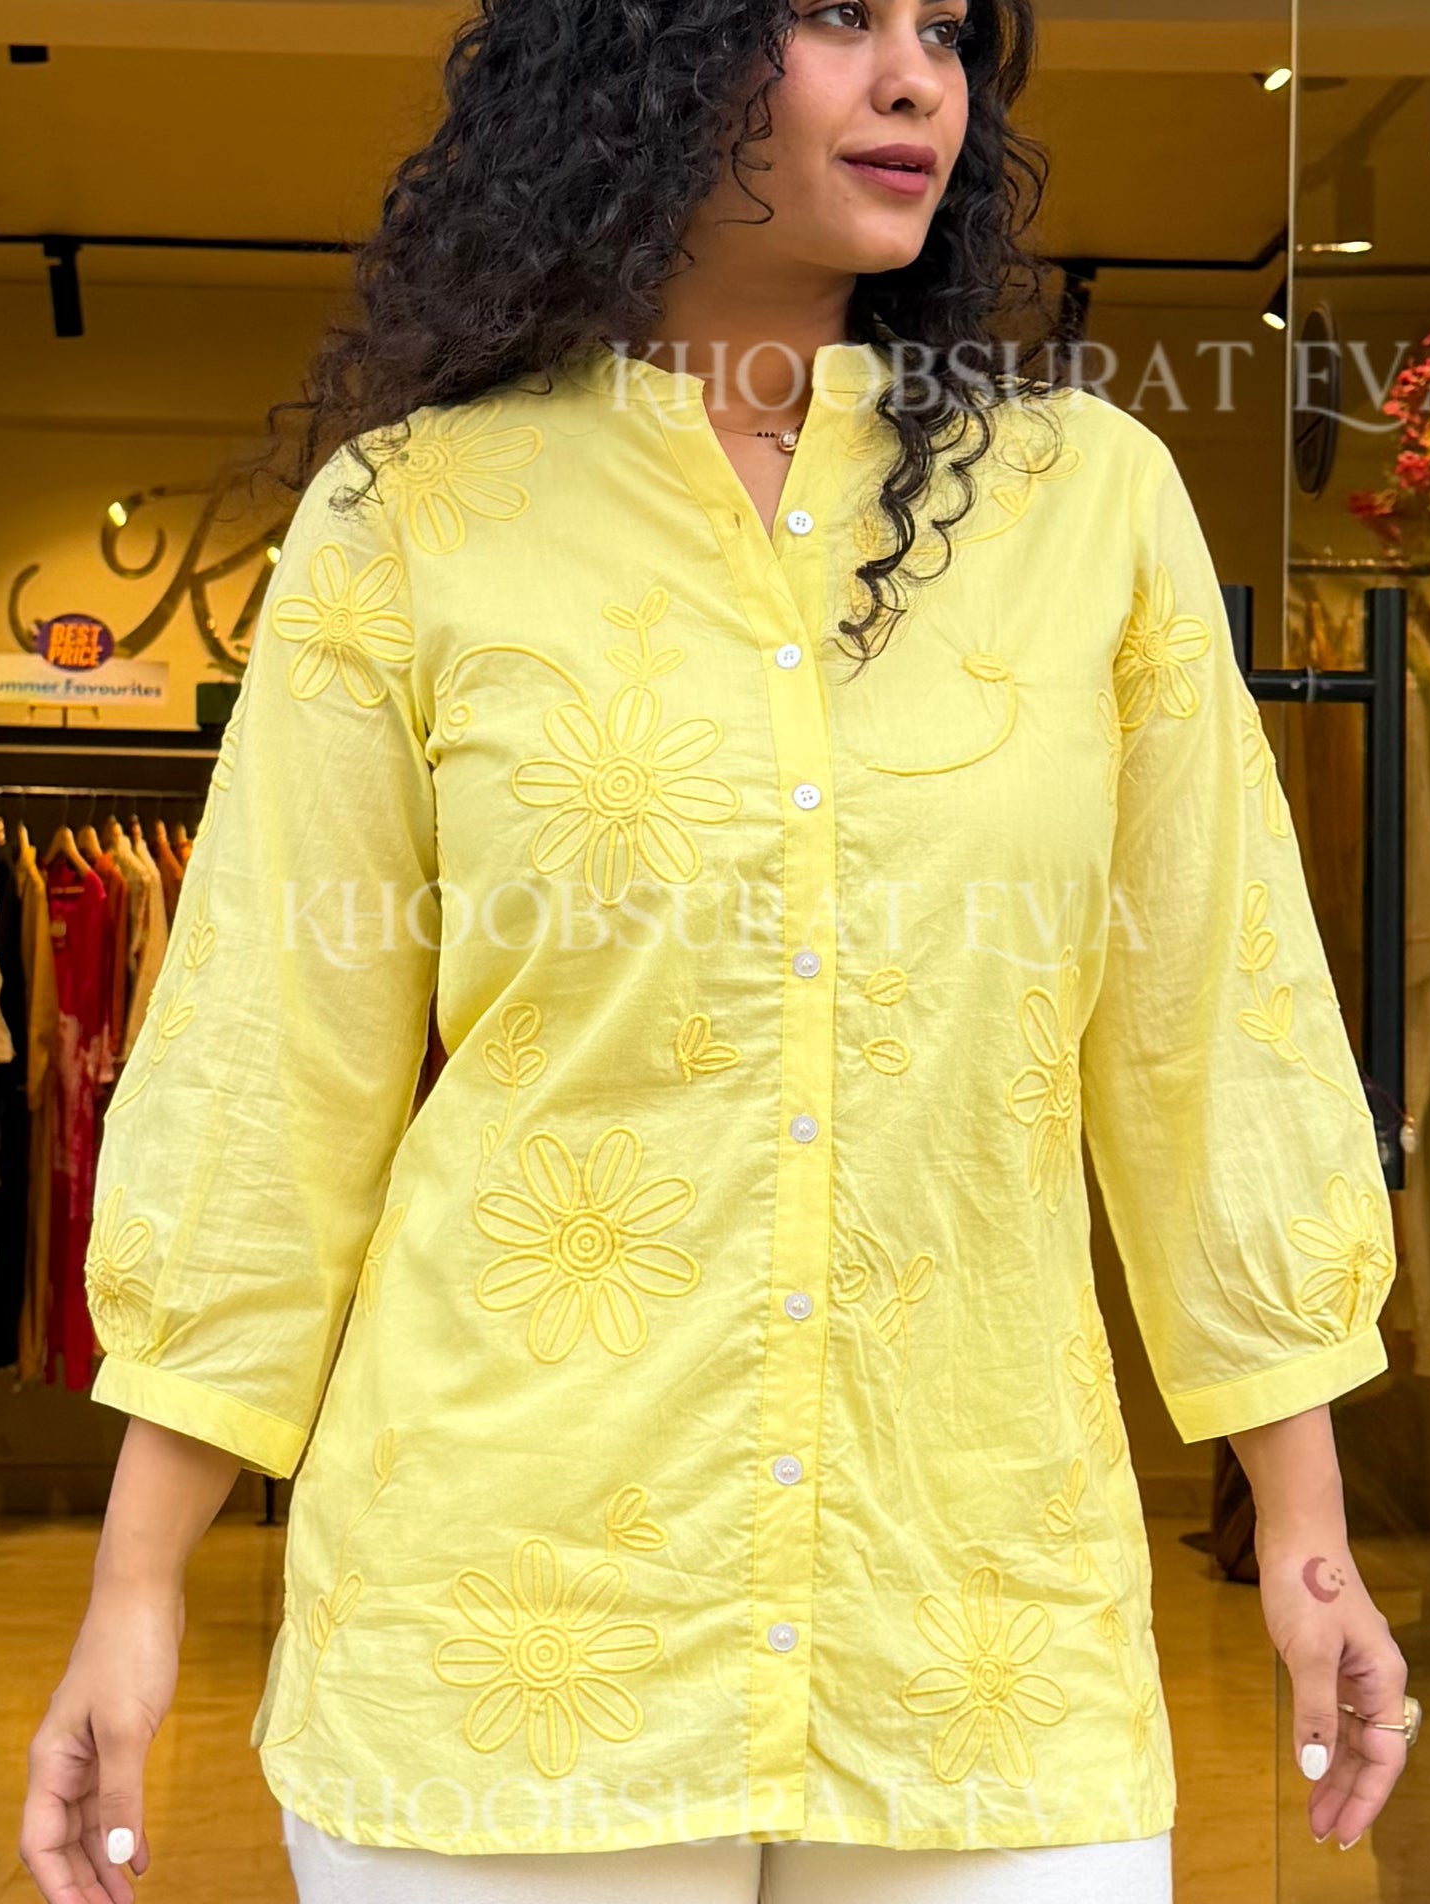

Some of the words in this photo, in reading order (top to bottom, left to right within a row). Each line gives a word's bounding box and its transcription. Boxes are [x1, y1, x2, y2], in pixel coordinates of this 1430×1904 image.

[49, 621, 103, 645] BEST
[47, 644, 103, 669] PRICE
[64, 678, 162, 698] Favourites
